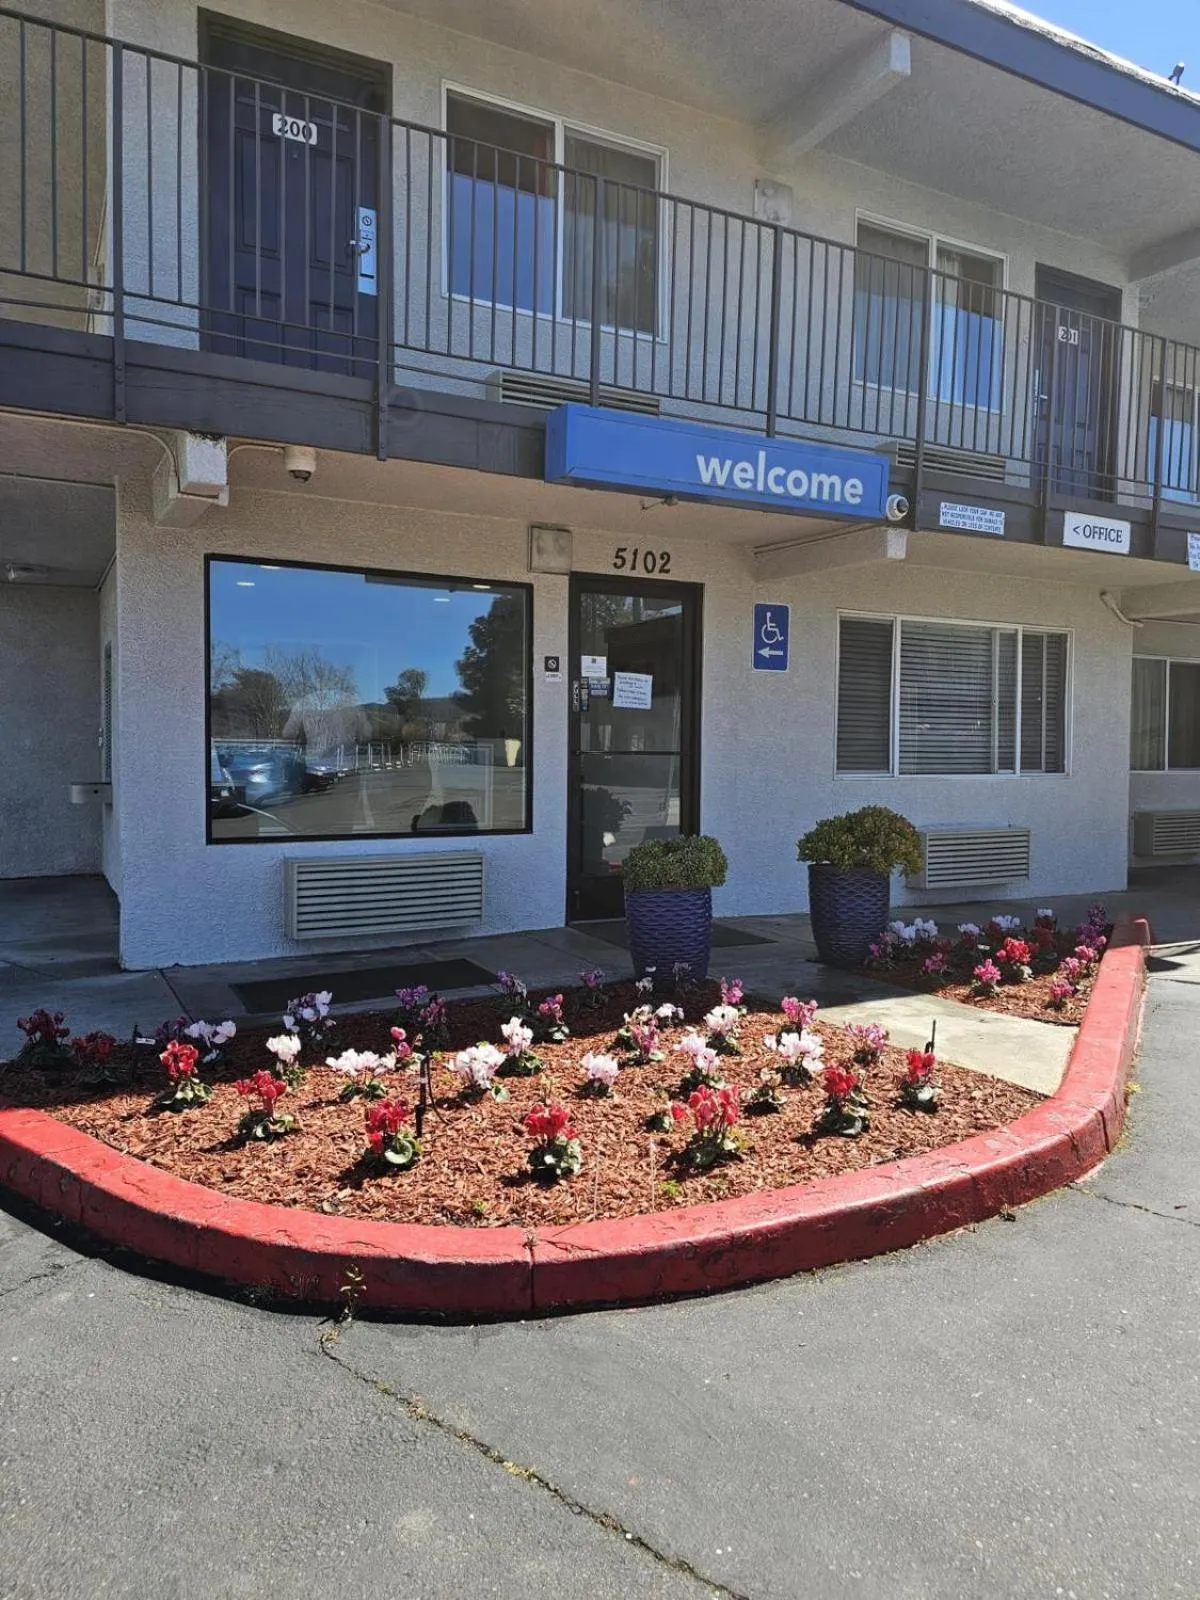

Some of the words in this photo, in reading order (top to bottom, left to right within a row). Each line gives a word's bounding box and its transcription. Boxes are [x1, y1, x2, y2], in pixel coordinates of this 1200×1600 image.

[278, 117, 312, 141] 200
[696, 450, 863, 504] welcome
[1083, 524, 1123, 543] OFFICE
[613, 547, 671, 574] 5102
